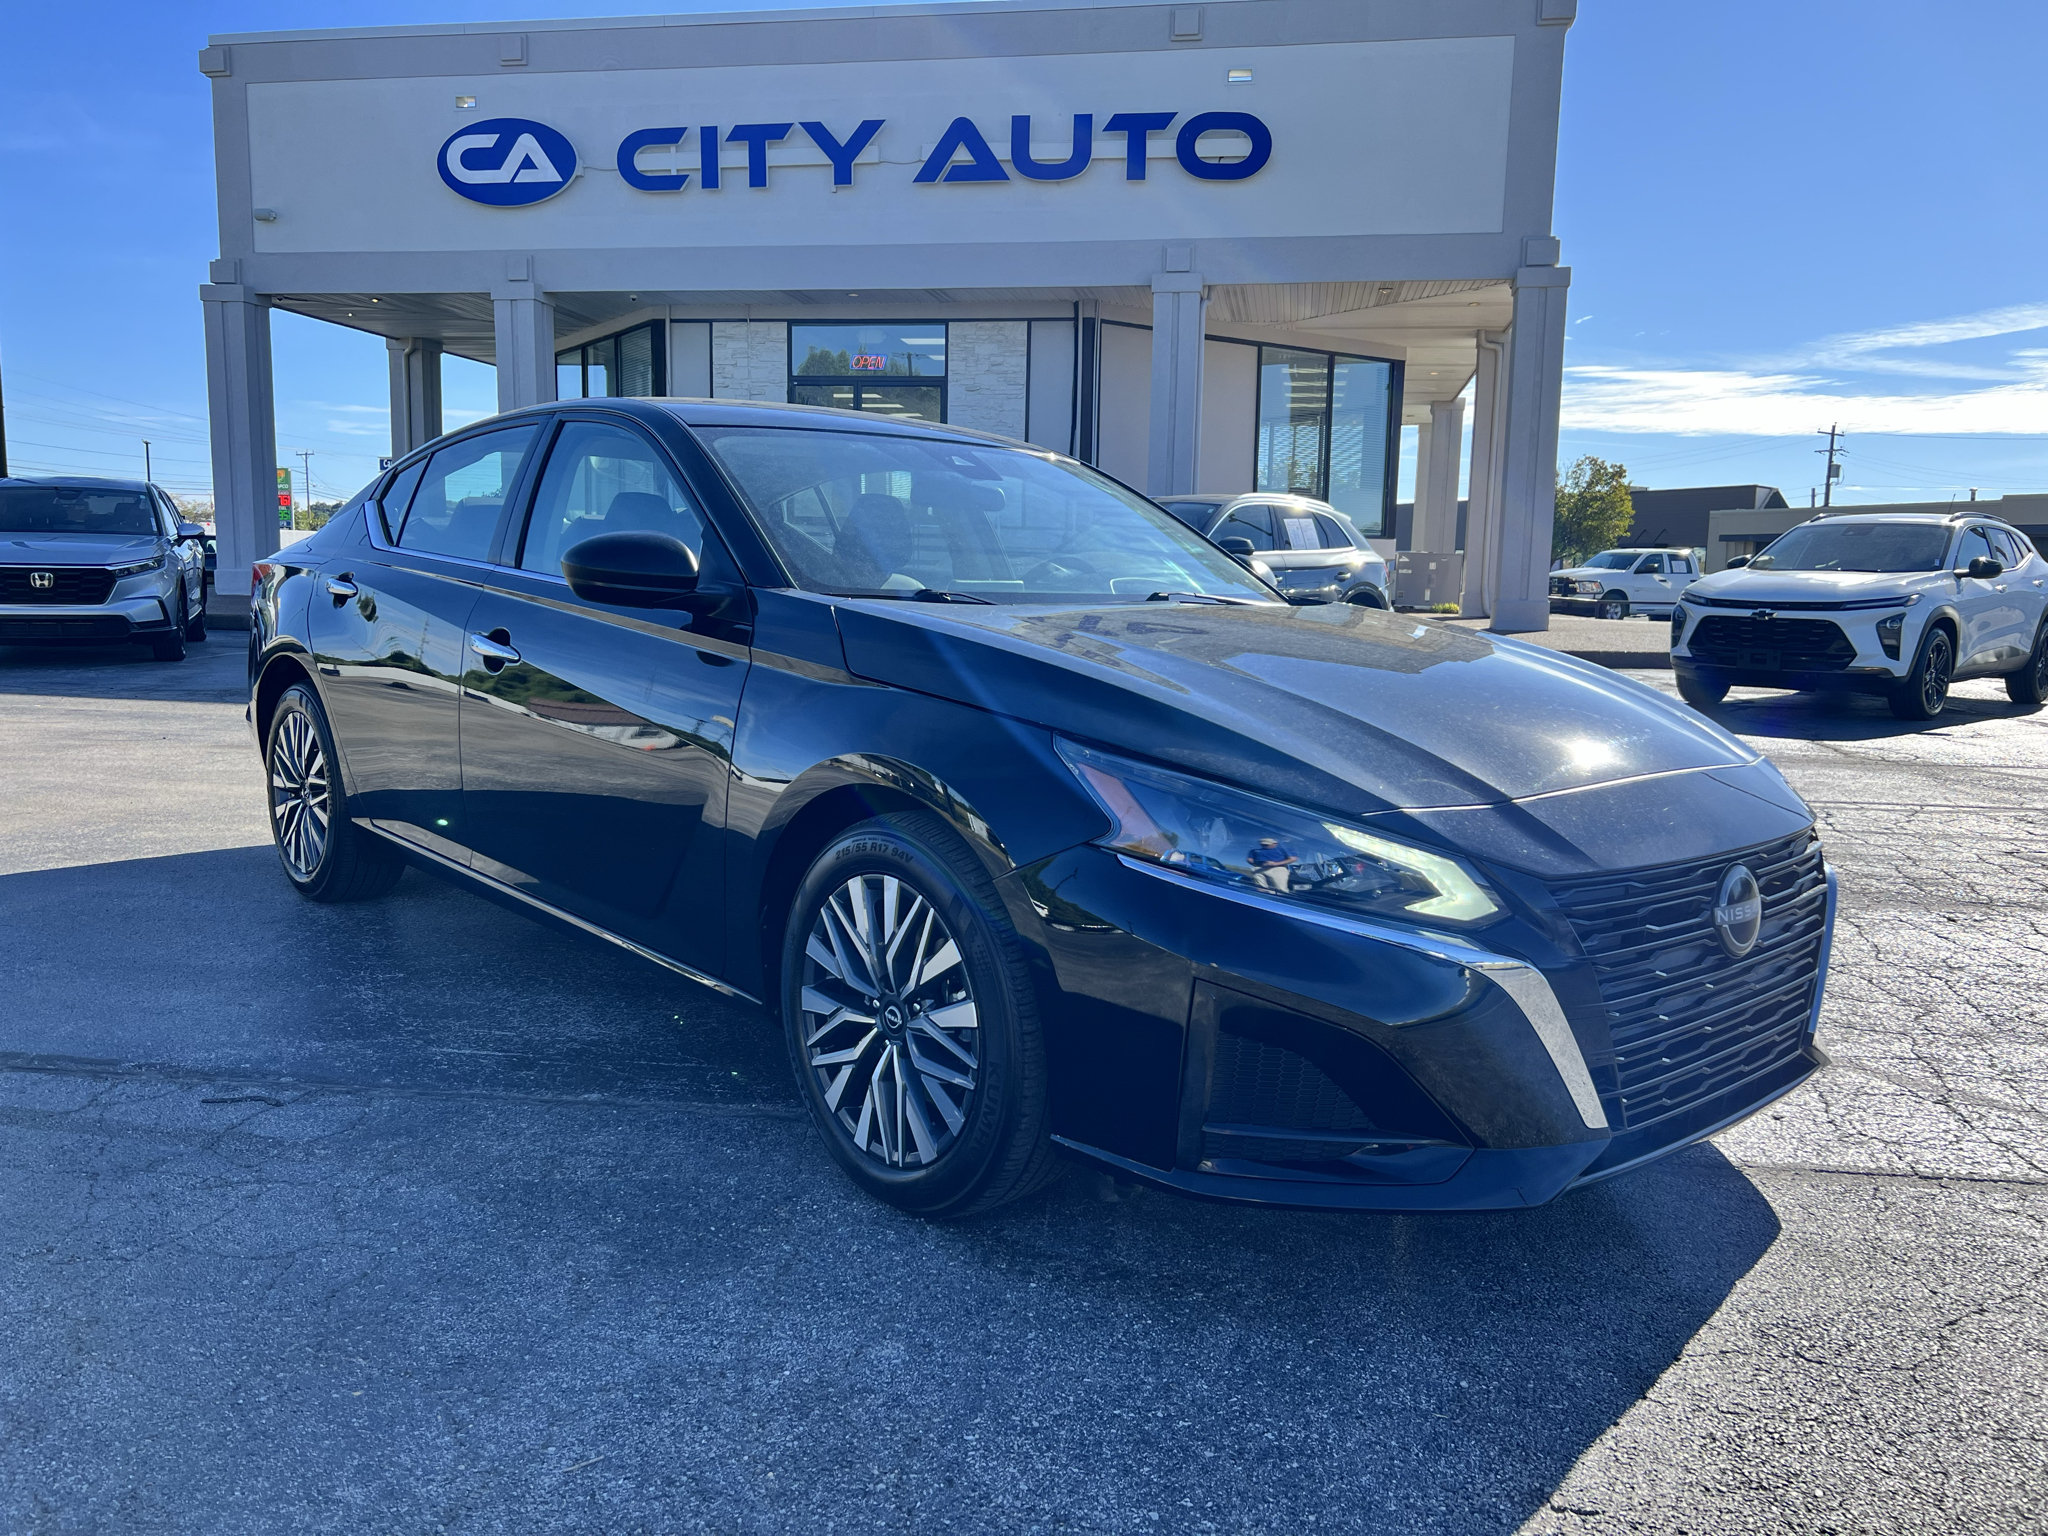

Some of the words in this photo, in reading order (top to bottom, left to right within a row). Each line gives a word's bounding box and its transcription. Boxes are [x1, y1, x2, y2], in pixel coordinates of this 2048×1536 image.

[446, 132, 564, 185] CA
[616, 119, 887, 192] CITY
[911, 111, 1273, 184] AUTO
[852, 356, 886, 369] OPEN
[835, 841, 869, 861] 215/55
[869, 841, 890, 854] R17
[890, 847, 914, 863] 94V
